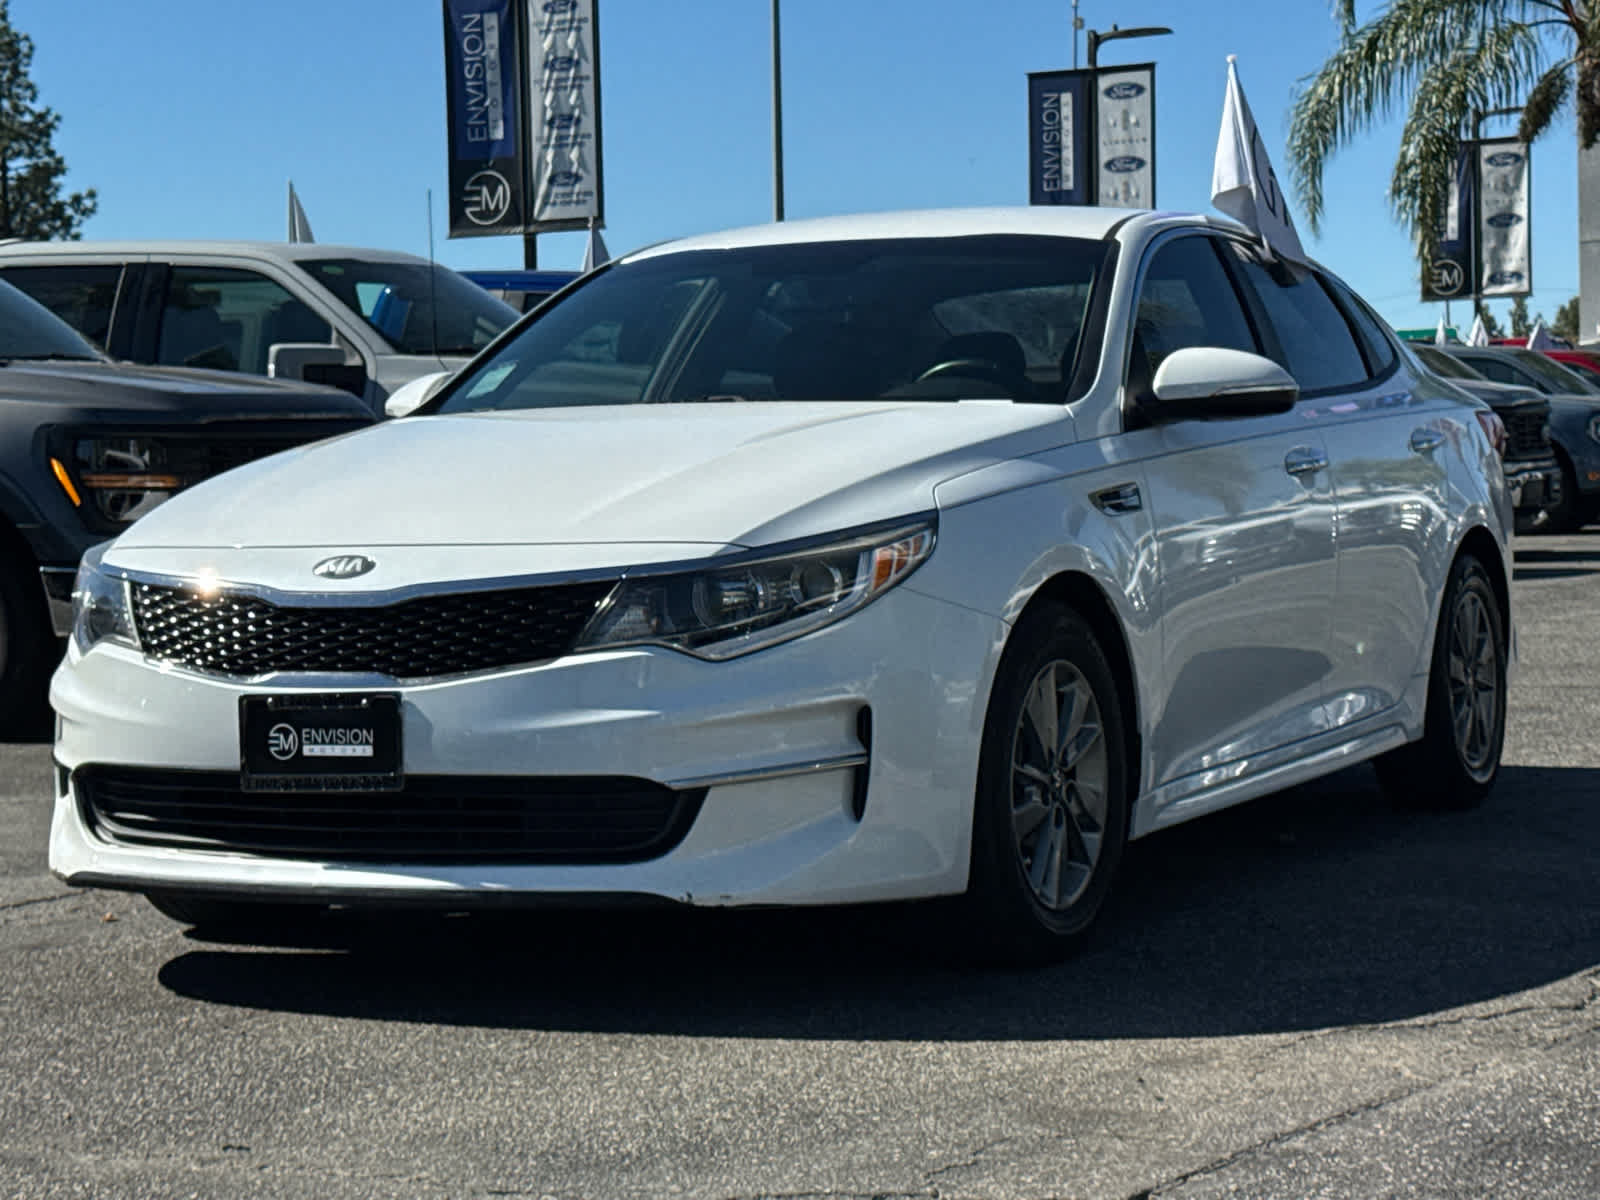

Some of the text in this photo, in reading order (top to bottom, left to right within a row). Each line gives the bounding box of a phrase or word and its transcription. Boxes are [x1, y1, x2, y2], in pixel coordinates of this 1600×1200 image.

[462, 13, 488, 142] ENVISION
[1042, 92, 1061, 192] ENVISION
[314, 558, 362, 576] KIA
[301, 728, 374, 745] ENVISION
